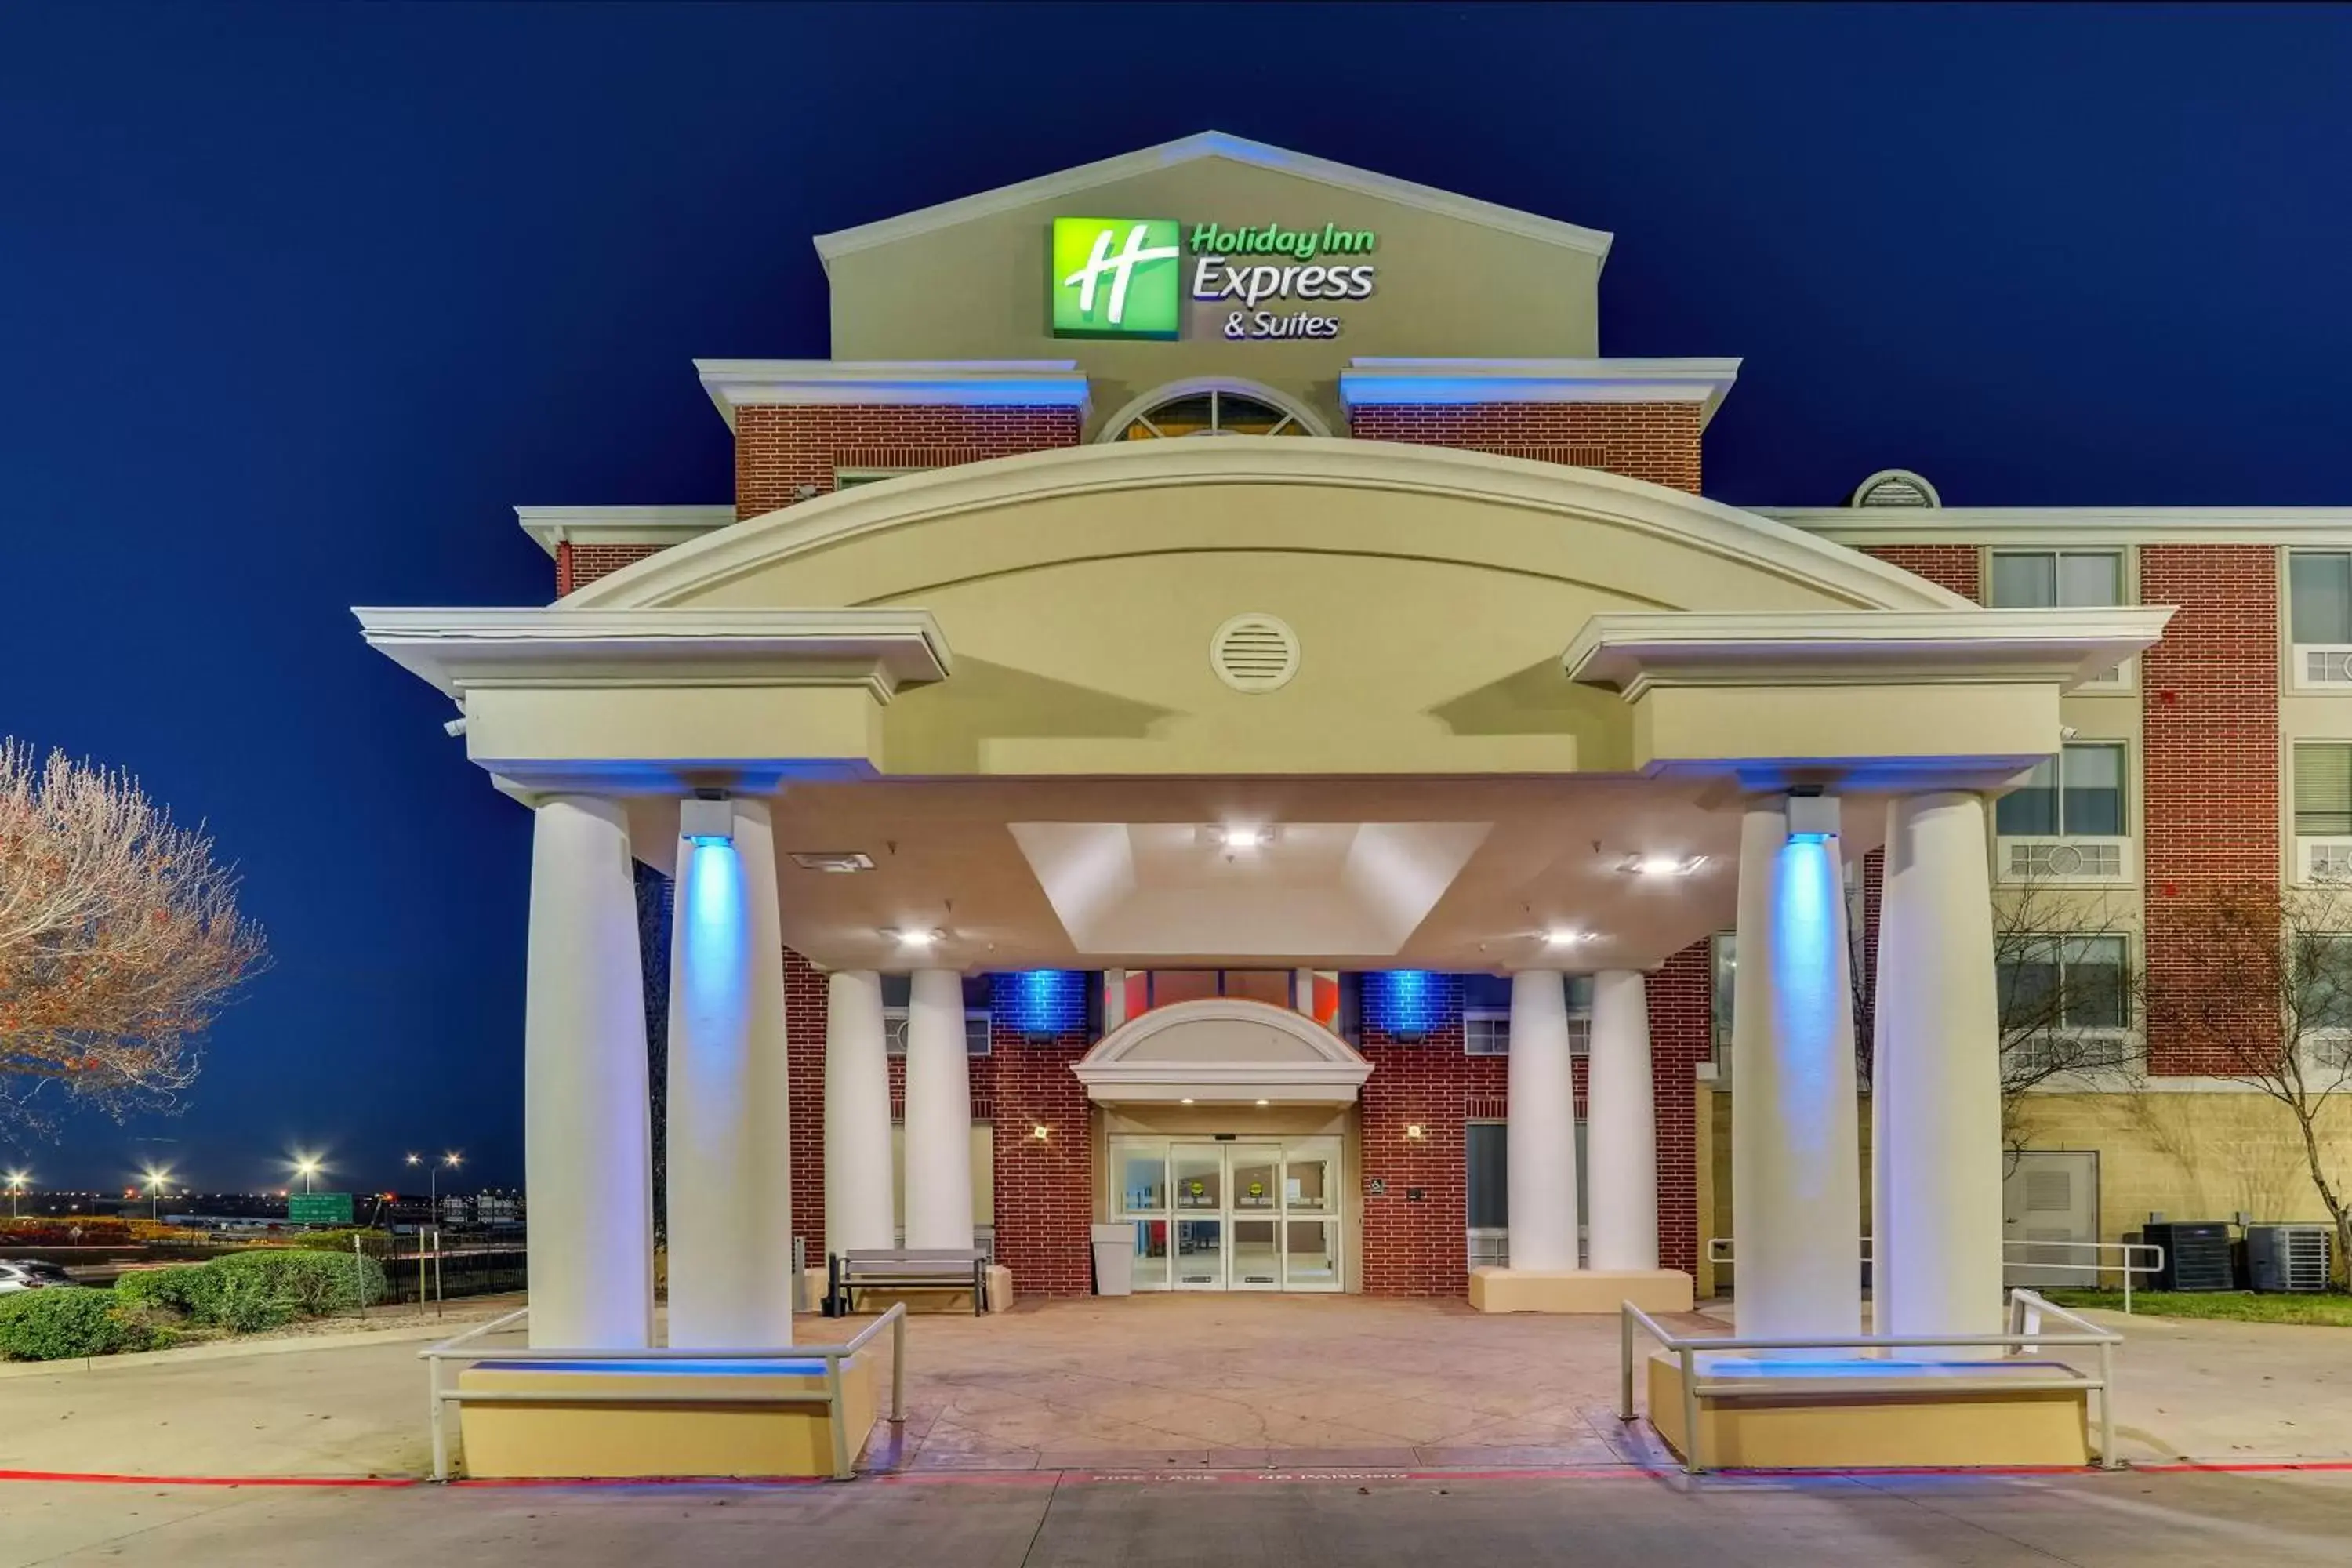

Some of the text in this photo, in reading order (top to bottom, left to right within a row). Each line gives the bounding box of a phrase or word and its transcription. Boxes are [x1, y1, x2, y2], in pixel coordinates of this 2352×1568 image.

[1191, 223, 1375, 260] Holiday Inn
[1192, 256, 1374, 308] Express
[1224, 311, 1339, 339] & Suites
